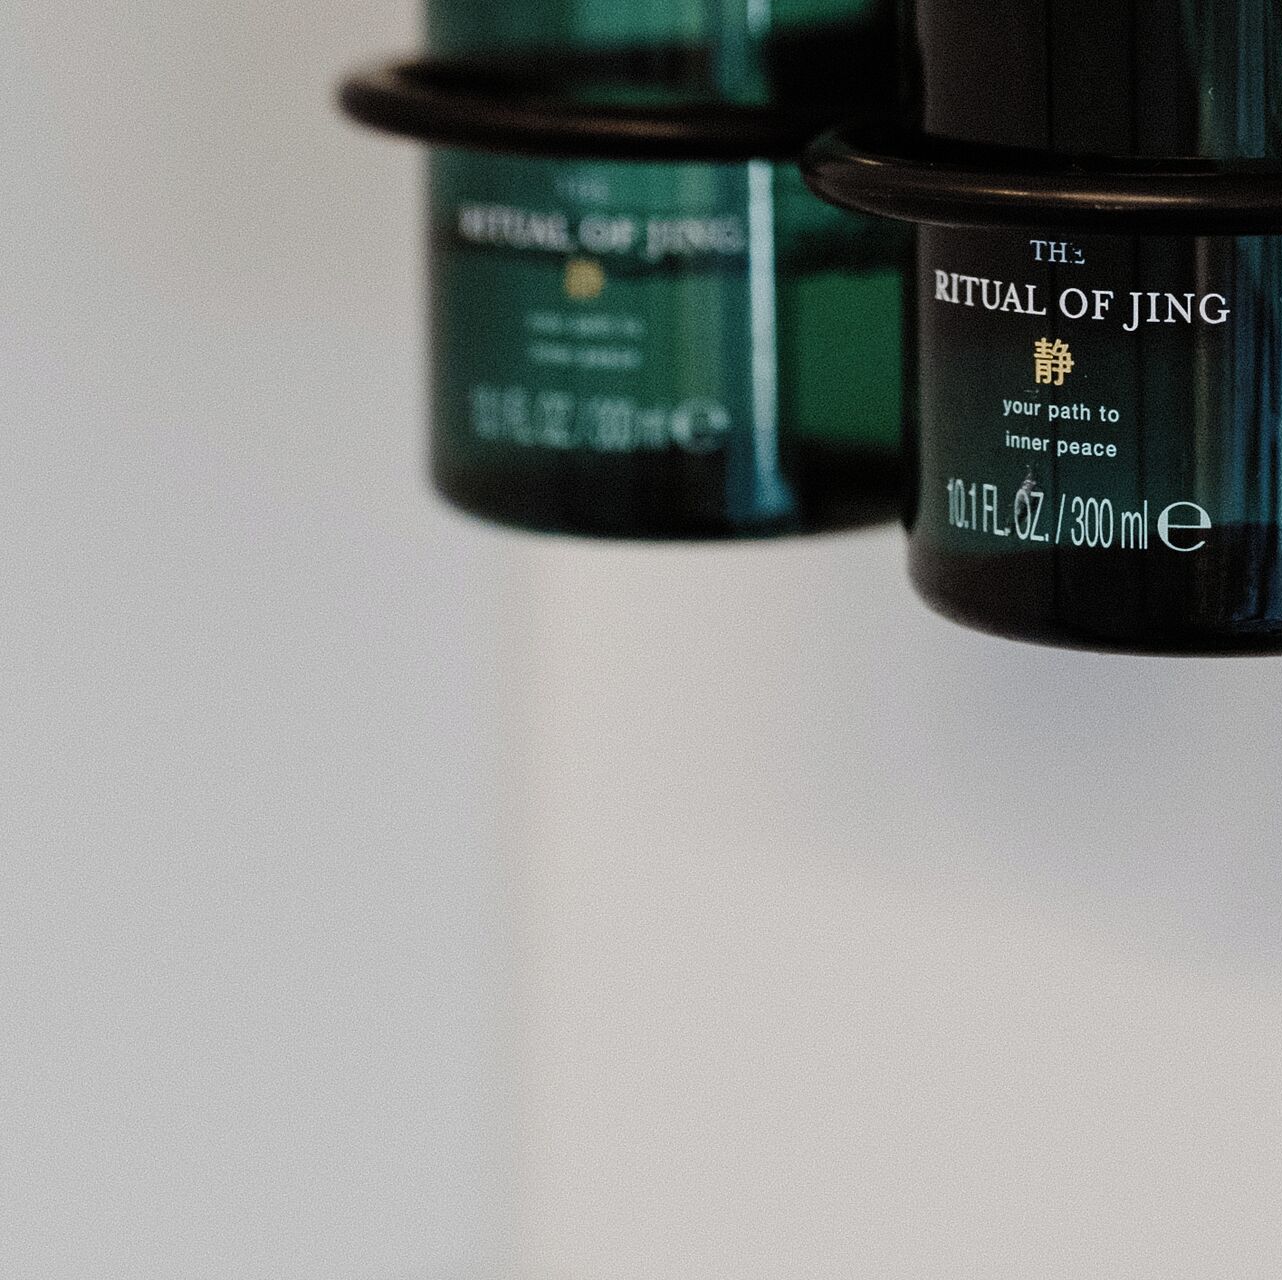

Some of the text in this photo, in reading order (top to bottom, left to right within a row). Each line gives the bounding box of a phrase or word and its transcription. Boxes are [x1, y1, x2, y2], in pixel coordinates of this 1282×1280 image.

[934, 269, 1231, 331] RITUAL OF JING
[1033, 337, 1075, 386] 静
[1002, 398, 1120, 423] your path to
[1005, 430, 1118, 458] inner peace
[947, 478, 977, 531] 10.1
[1014, 487, 1049, 542] OZ.
[1071, 495, 1114, 548] 300
[1121, 499, 1149, 550] ml
